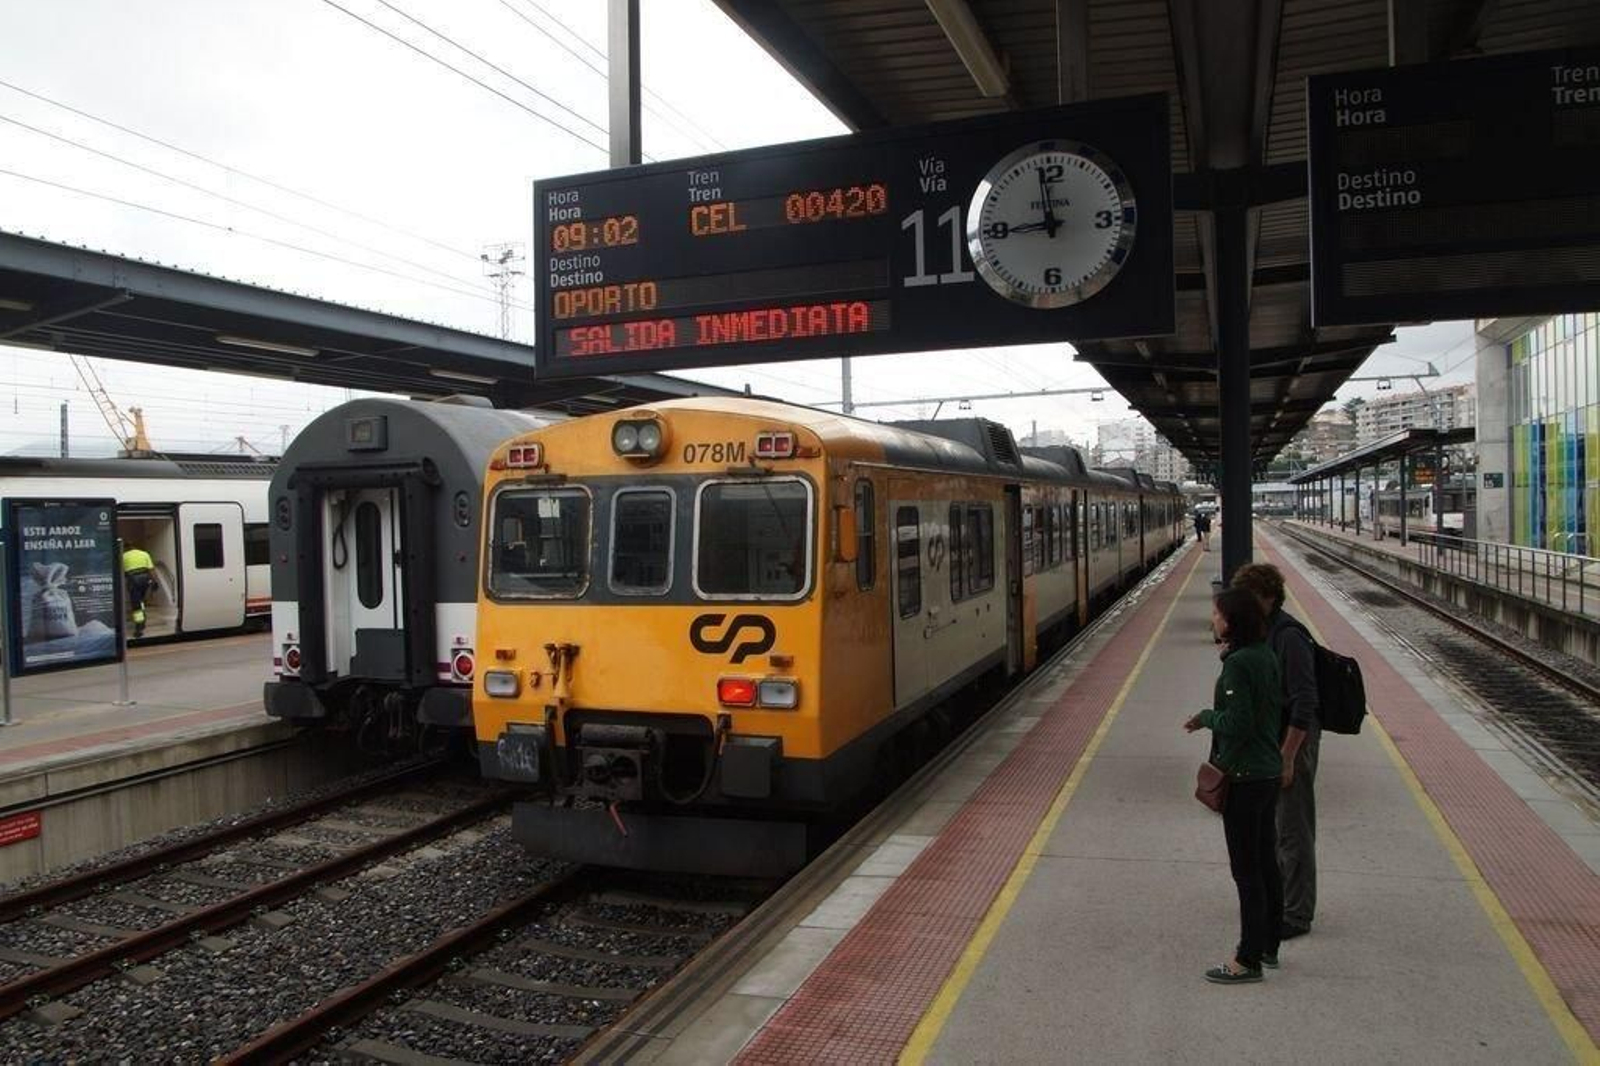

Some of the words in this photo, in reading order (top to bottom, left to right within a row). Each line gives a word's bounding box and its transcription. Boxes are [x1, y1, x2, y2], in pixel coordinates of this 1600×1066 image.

[1552, 65, 1600, 84] Tren
[1335, 87, 1383, 106] Hora
[1552, 86, 1600, 105] Tren
[1336, 108, 1386, 127] Hora
[919, 157, 945, 176] Vía
[687, 170, 719, 186] Tren
[920, 175, 947, 193] Vía
[1337, 168, 1416, 190] Destino
[549, 190, 579, 206] Hora
[688, 186, 722, 202] Tren
[1338, 188, 1421, 210] Destino
[549, 205, 582, 222] Hora
[691, 204, 747, 237] CEL
[785, 184, 887, 224] 00420
[1094, 210, 1113, 230] 3
[553, 216, 639, 251] 09:02
[991, 222, 1009, 239] 9
[901, 205, 976, 287] 11
[550, 254, 601, 272] Destino
[550, 269, 604, 288] Destino
[1044, 267, 1062, 286] 6
[553, 282, 658, 320] OPORTO
[569, 319, 677, 357] SALIDA
[695, 302, 869, 347] INMEDIATA
[683, 442, 746, 464] 078M
[24, 526, 47, 537] ESTE
[49, 525, 82, 536] ARROZ
[24, 538, 63, 551] ENSEÑA
[65, 540, 72, 550] A
[74, 538, 96, 549] LEER
